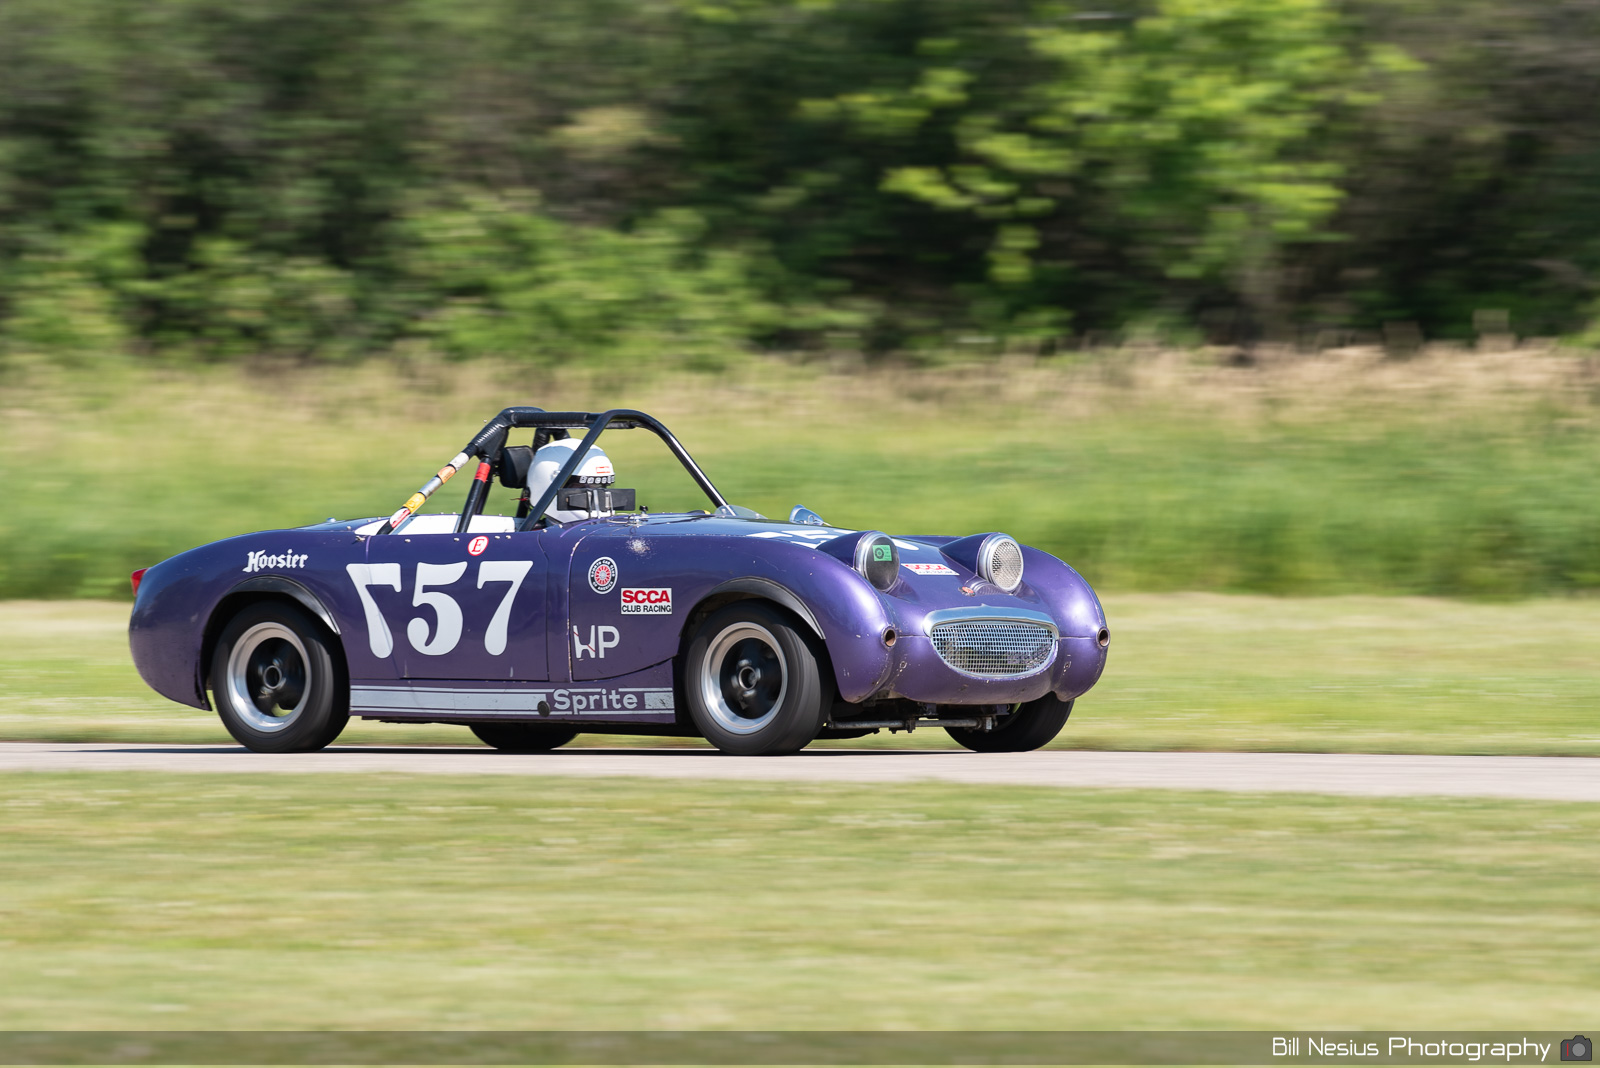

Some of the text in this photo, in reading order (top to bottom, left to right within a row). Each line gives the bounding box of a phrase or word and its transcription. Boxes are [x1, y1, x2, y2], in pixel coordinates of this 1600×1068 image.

[242, 548, 309, 573] Hoosier
[345, 560, 534, 659] 757
[621, 604, 672, 613] CLUB RACING
[622, 589, 671, 604] SCCA
[572, 624, 620, 659] HP
[553, 688, 639, 715] Sprite
